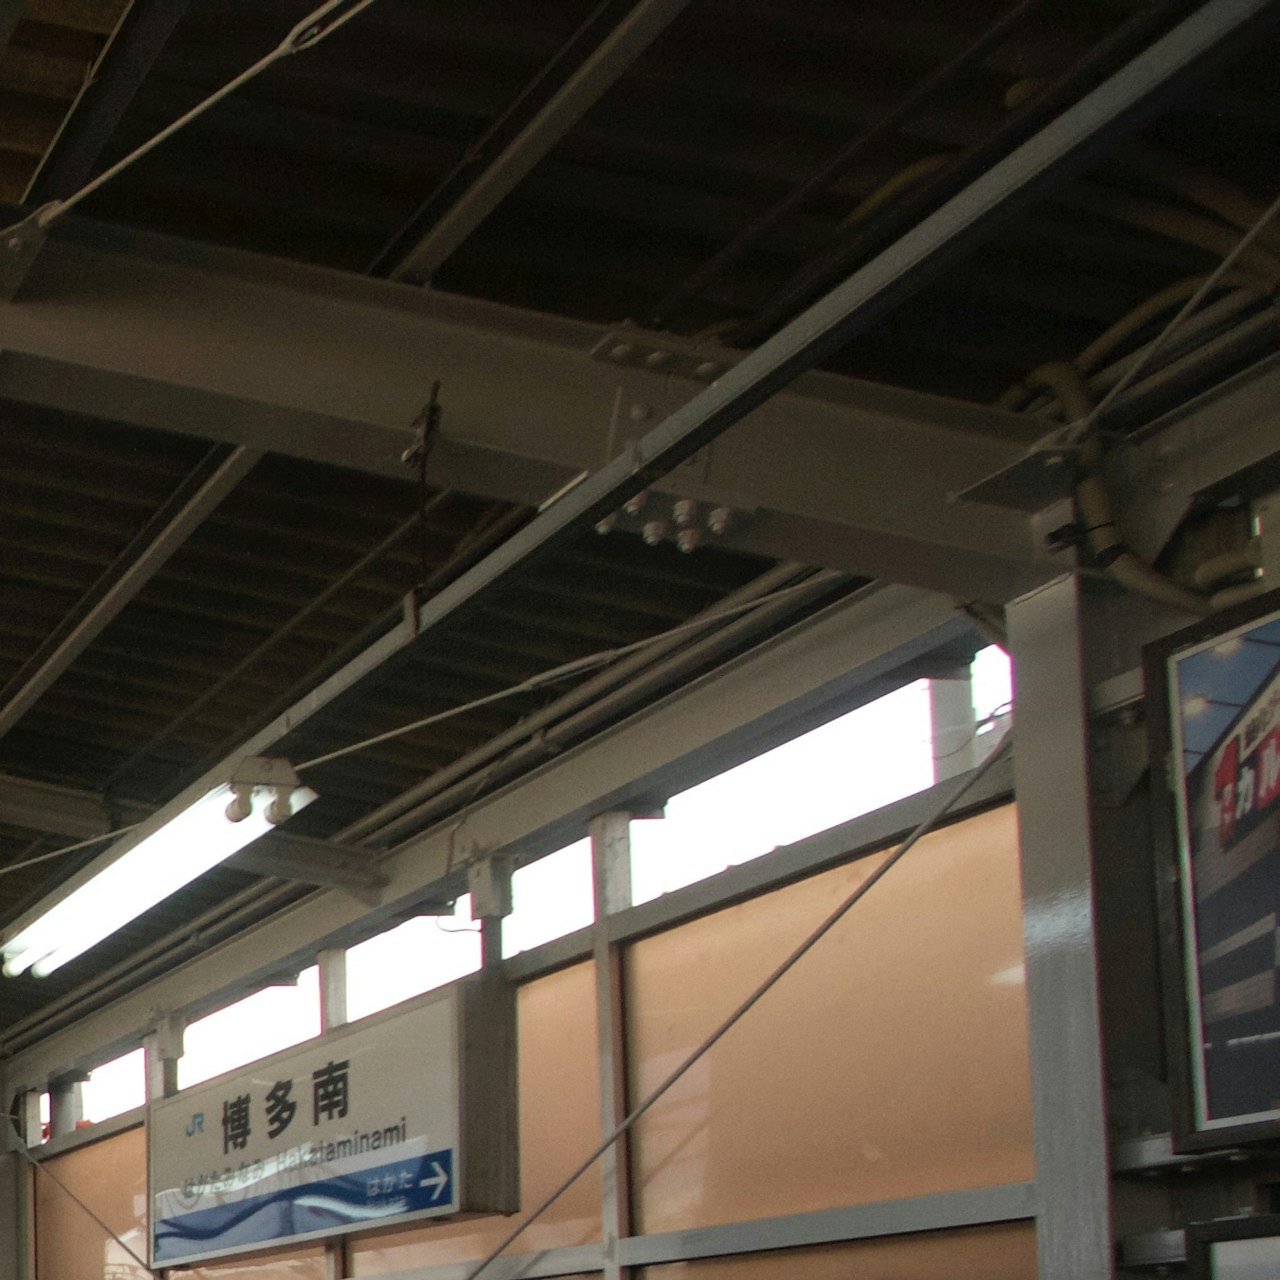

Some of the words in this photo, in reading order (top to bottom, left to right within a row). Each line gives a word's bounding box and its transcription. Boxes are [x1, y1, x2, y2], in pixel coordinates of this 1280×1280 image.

[185, 1112, 205, 1138] JR
[221, 1059, 350, 1154] 博多南
[277, 1117, 407, 1175] Hakataminami
[366, 1167, 414, 1197] はかた
